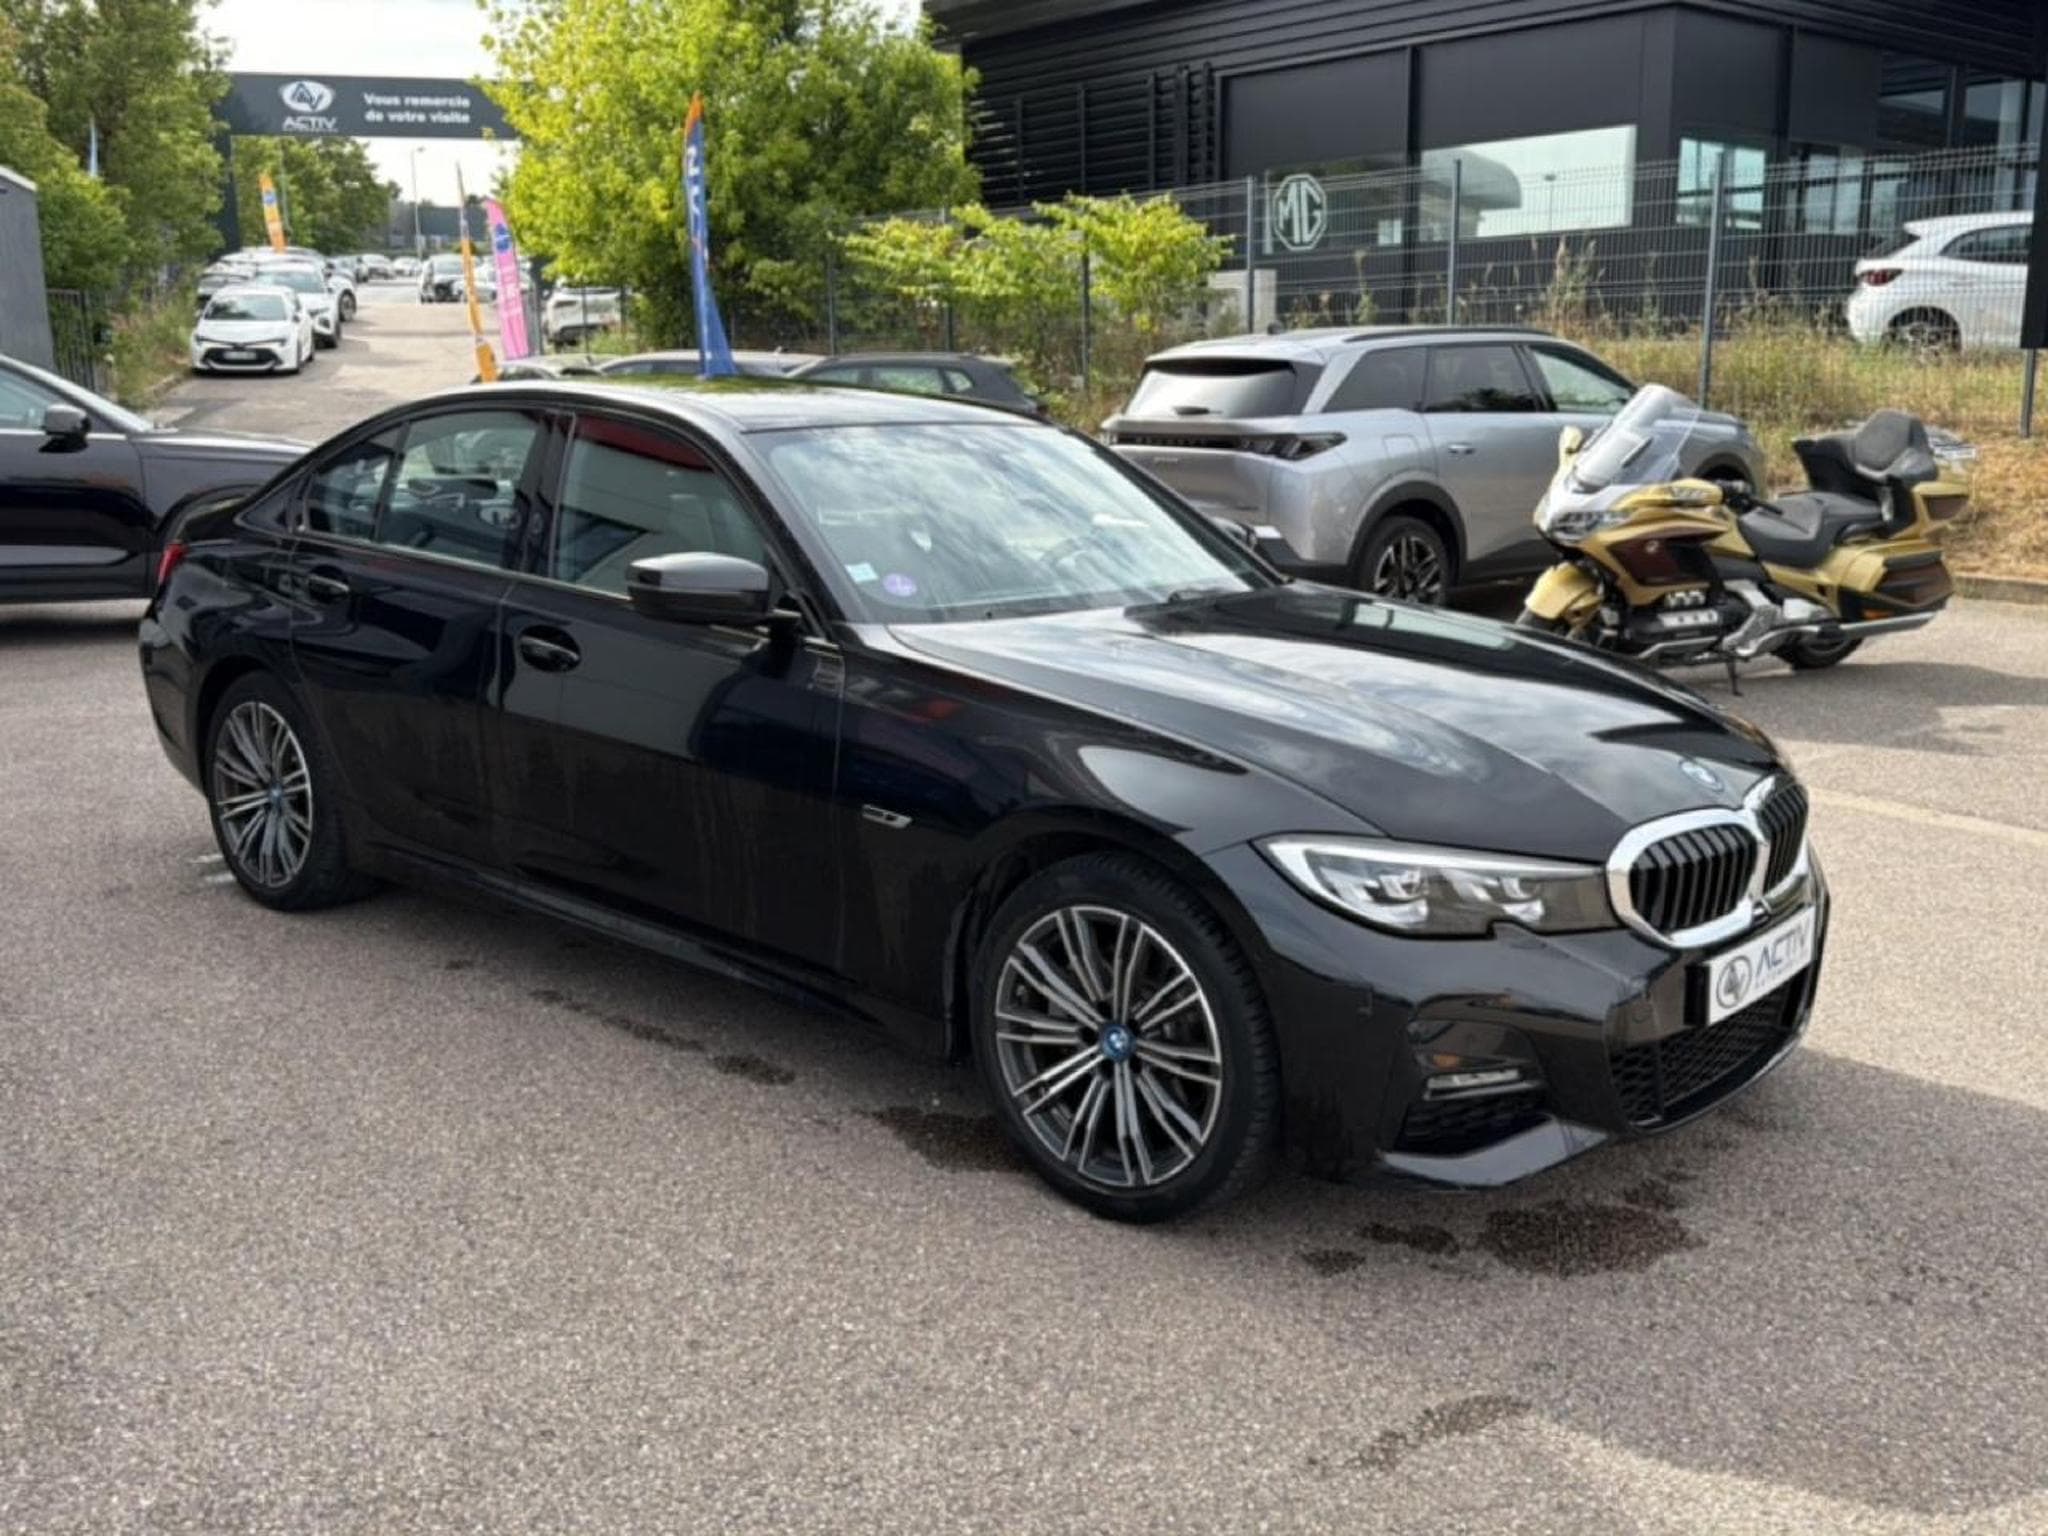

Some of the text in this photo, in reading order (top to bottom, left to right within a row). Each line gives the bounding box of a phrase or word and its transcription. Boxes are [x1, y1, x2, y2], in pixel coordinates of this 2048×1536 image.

[363, 92, 471, 108] Vous remercie
[282, 116, 338, 129] ACTIV
[365, 110, 471, 124] de votre visite
[1279, 181, 1322, 243] MG
